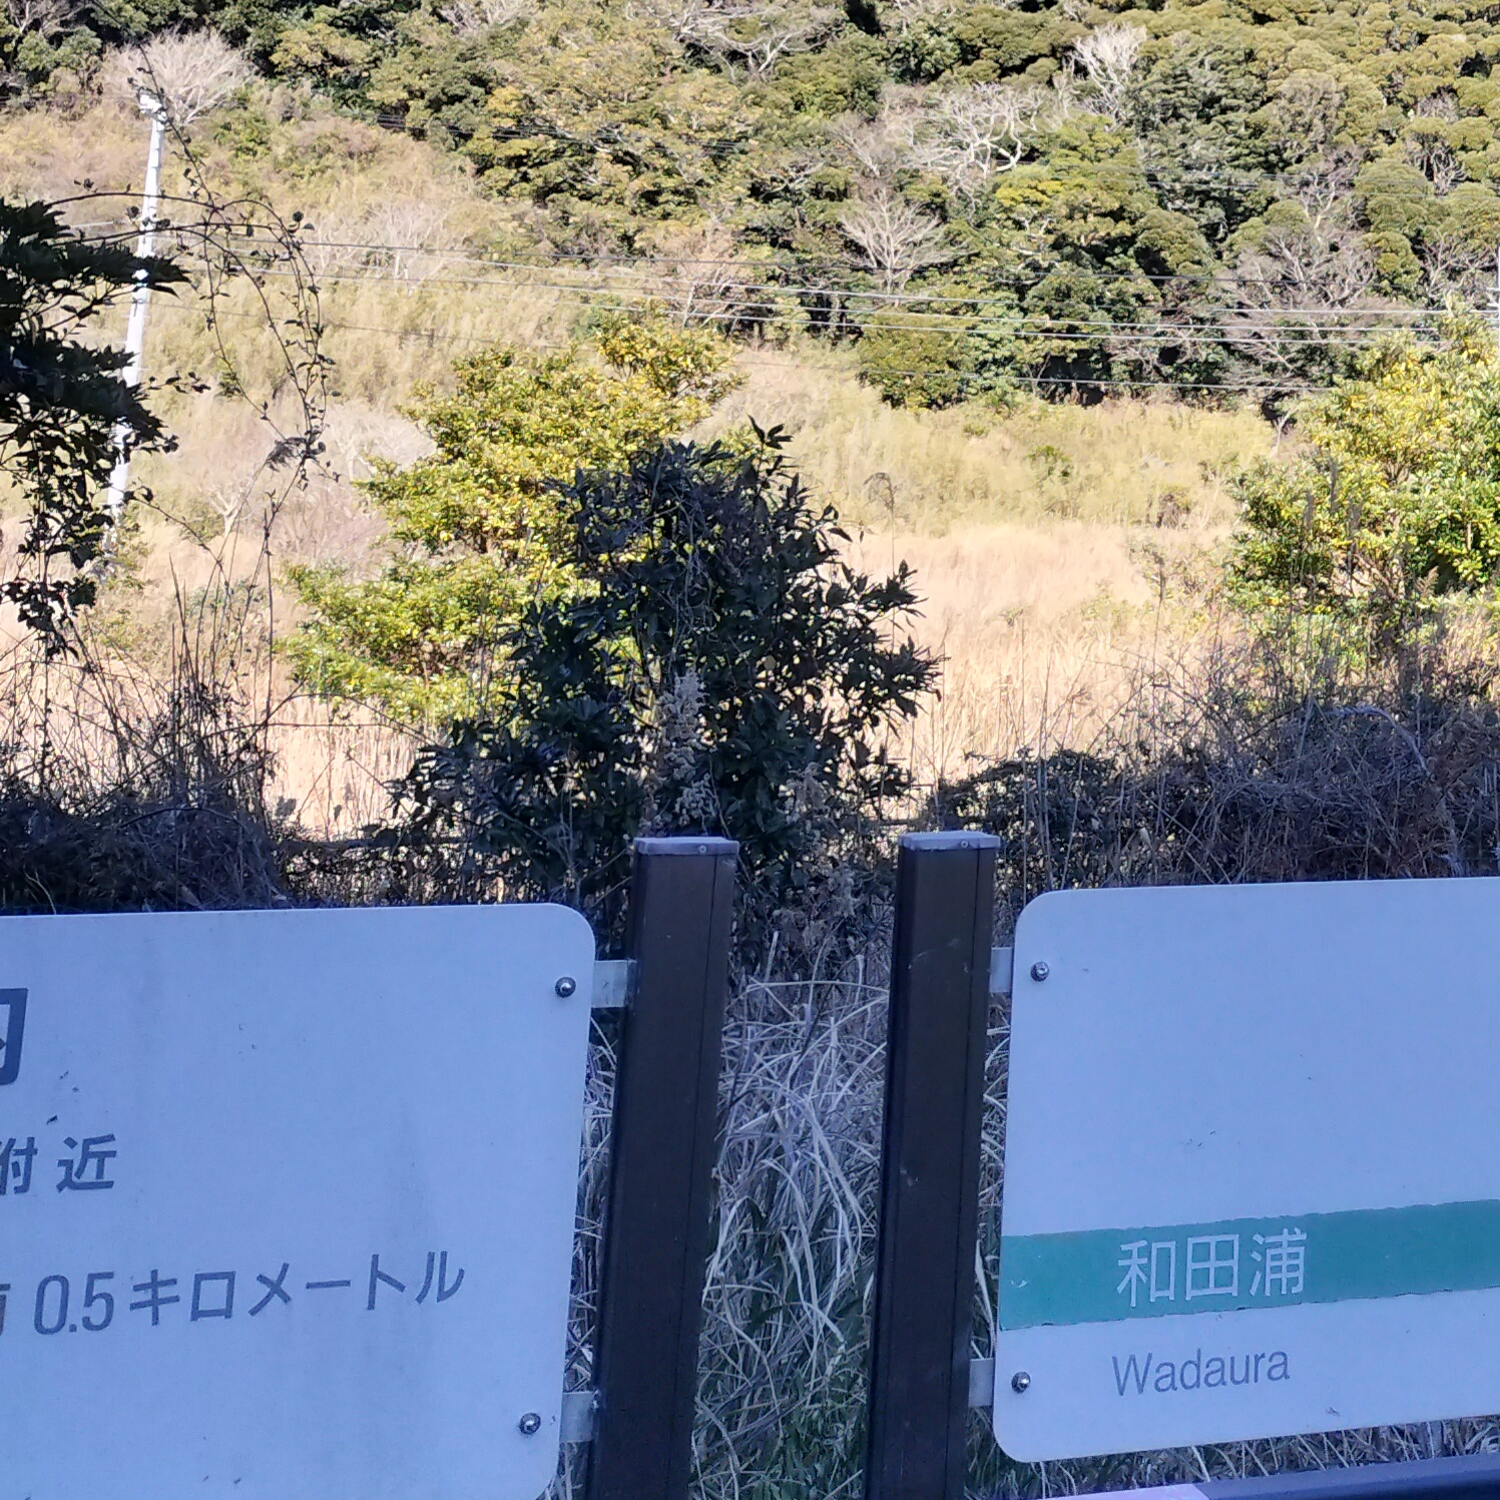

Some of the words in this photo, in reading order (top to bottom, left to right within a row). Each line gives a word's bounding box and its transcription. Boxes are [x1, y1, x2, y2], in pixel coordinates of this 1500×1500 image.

[0, 1251, 465, 1336] 0.5キロメートル
[1117, 1228, 1307, 1307] 和田浦
[1112, 1348, 1290, 1396] Wadaura
